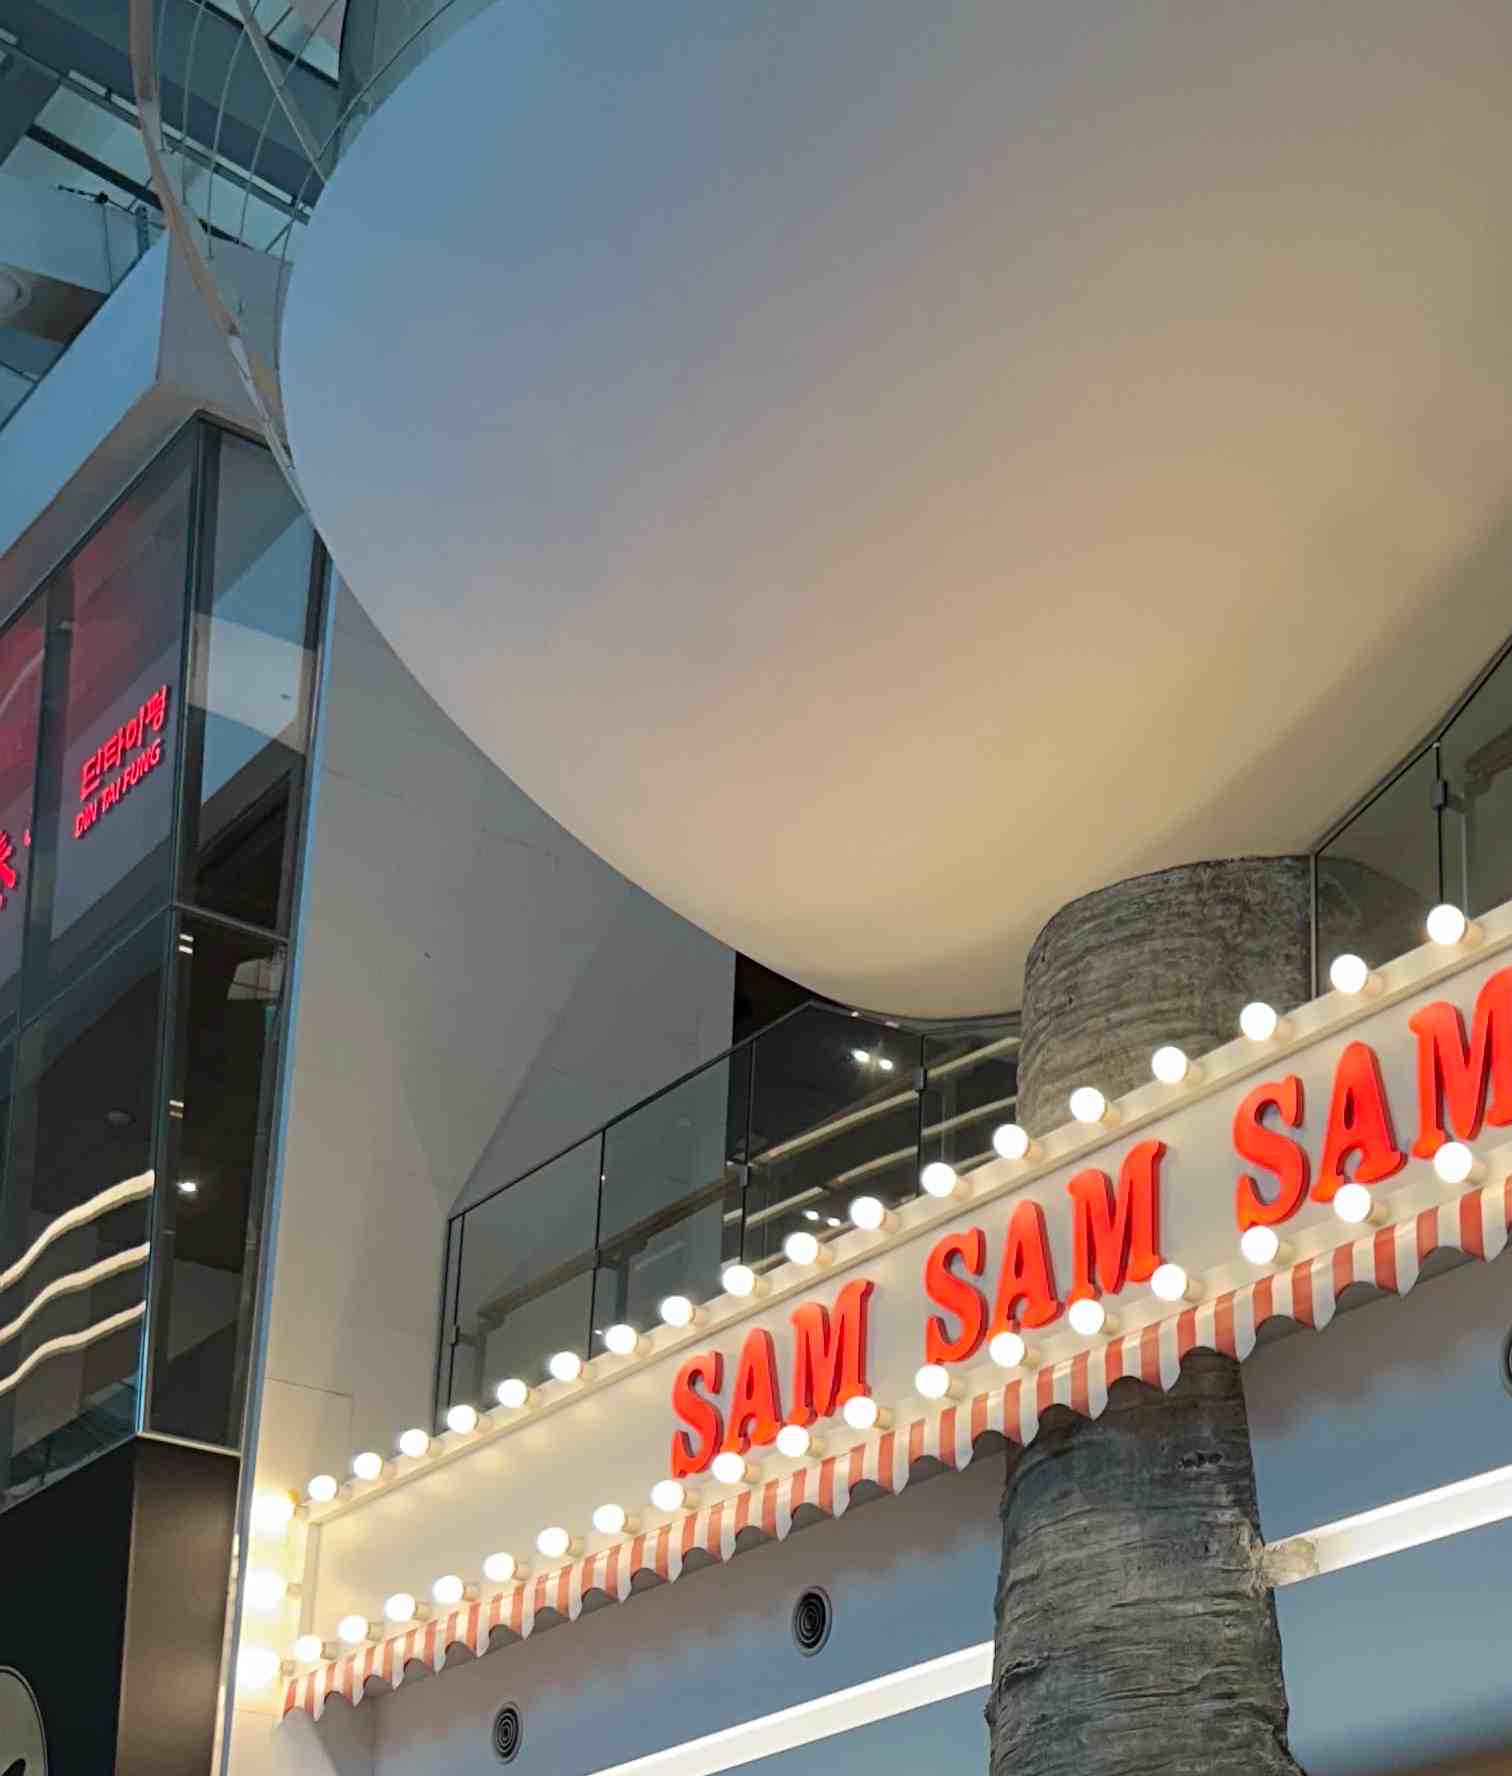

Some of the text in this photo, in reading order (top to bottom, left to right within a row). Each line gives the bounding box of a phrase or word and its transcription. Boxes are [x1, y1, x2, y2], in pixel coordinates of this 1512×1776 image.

[74, 737, 161, 839] DIN TAI FUNG
[671, 1279, 875, 1478] SAM
[924, 1140, 1166, 1365] SAM
